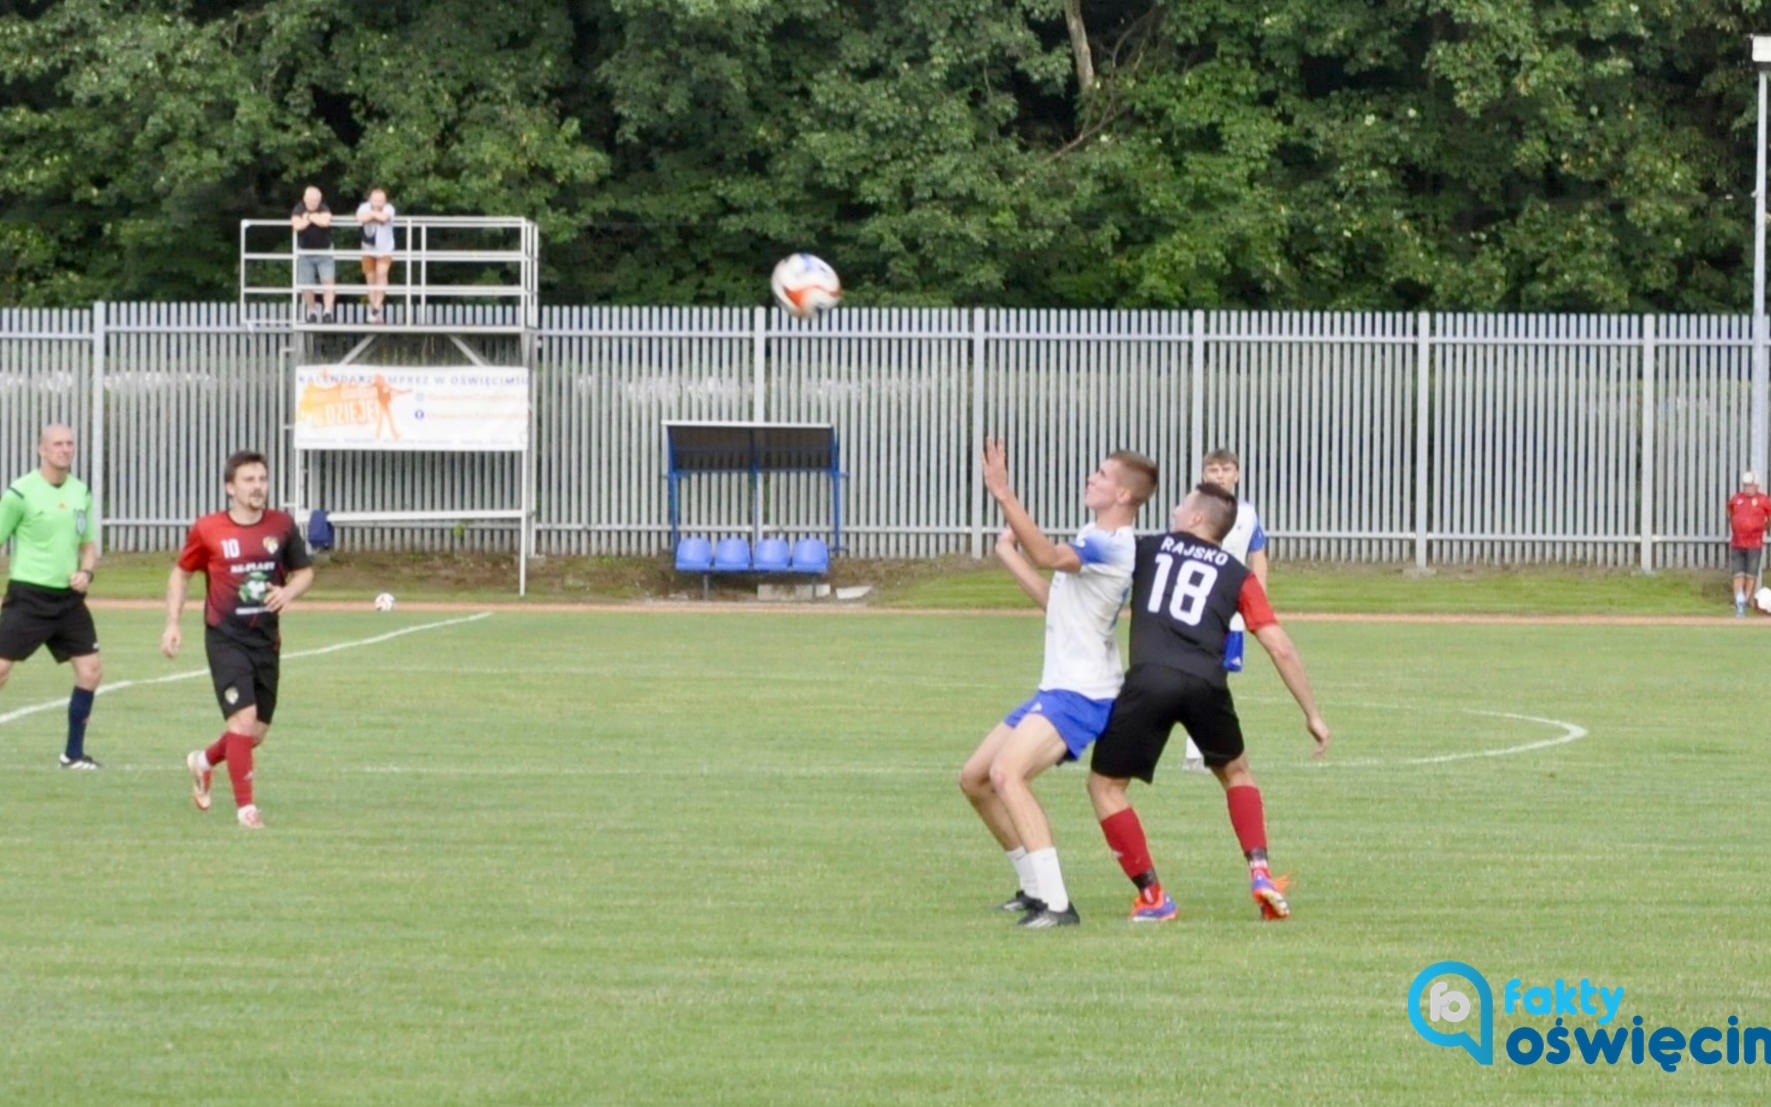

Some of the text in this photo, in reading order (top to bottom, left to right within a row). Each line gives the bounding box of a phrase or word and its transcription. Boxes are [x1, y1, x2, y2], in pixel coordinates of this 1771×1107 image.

[382, 375, 429, 386] MPREZ
[221, 538, 240, 559] 10
[1160, 536, 1229, 566] RAJSKO
[1147, 552, 1218, 627] 18
